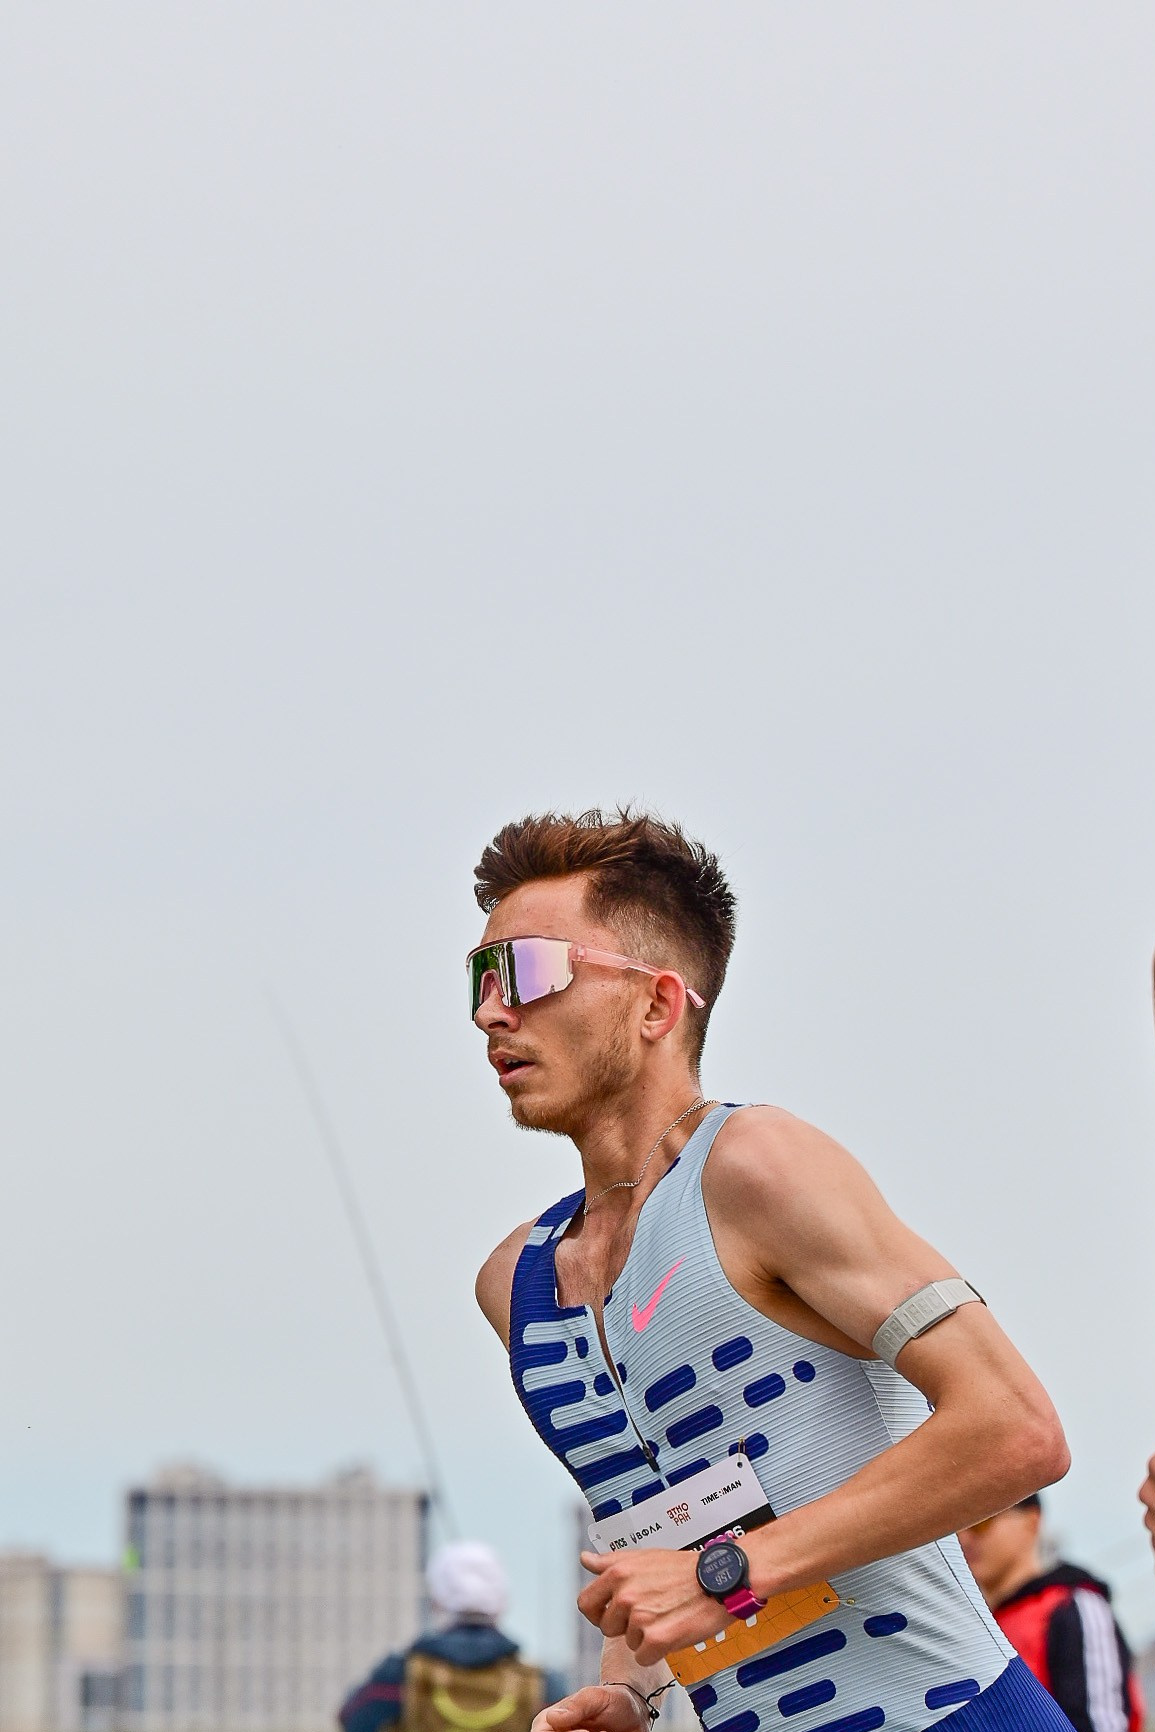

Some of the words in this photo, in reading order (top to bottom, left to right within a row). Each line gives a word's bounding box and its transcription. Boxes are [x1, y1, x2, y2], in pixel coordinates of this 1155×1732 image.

[666, 1502, 689, 1519] ЭТНО
[673, 1512, 691, 1526] РАН
[636, 1522, 662, 1541] ВФЛА
